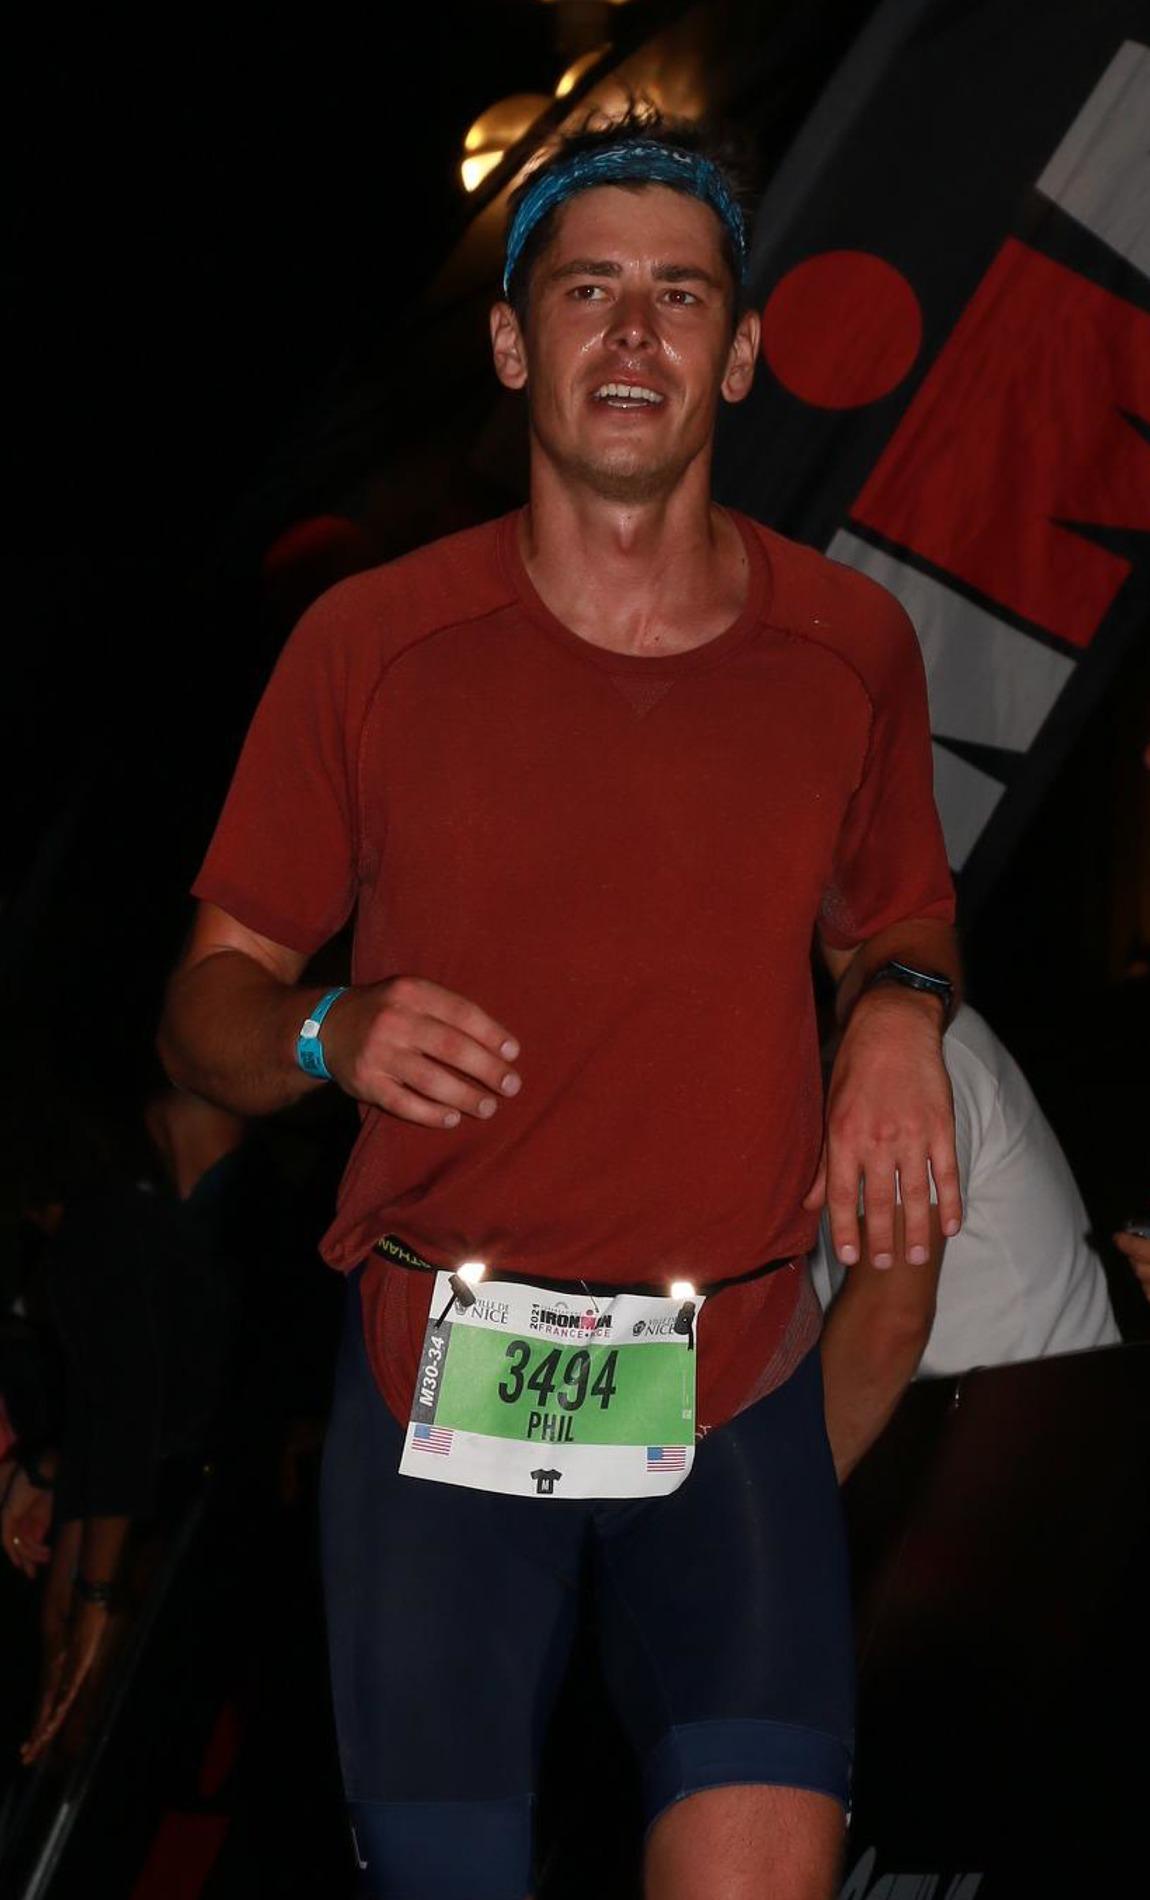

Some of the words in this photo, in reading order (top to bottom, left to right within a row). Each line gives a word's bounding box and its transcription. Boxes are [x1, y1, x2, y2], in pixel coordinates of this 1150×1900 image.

[471, 1306, 508, 1324] NICE
[530, 1303, 540, 1330] 2021
[540, 1309, 613, 1330] IRONMAN
[538, 1323, 584, 1339] FRANCE
[419, 1335, 444, 1407] M30-34
[498, 1339, 620, 1411] 3494
[527, 1411, 575, 1442] PHIL
